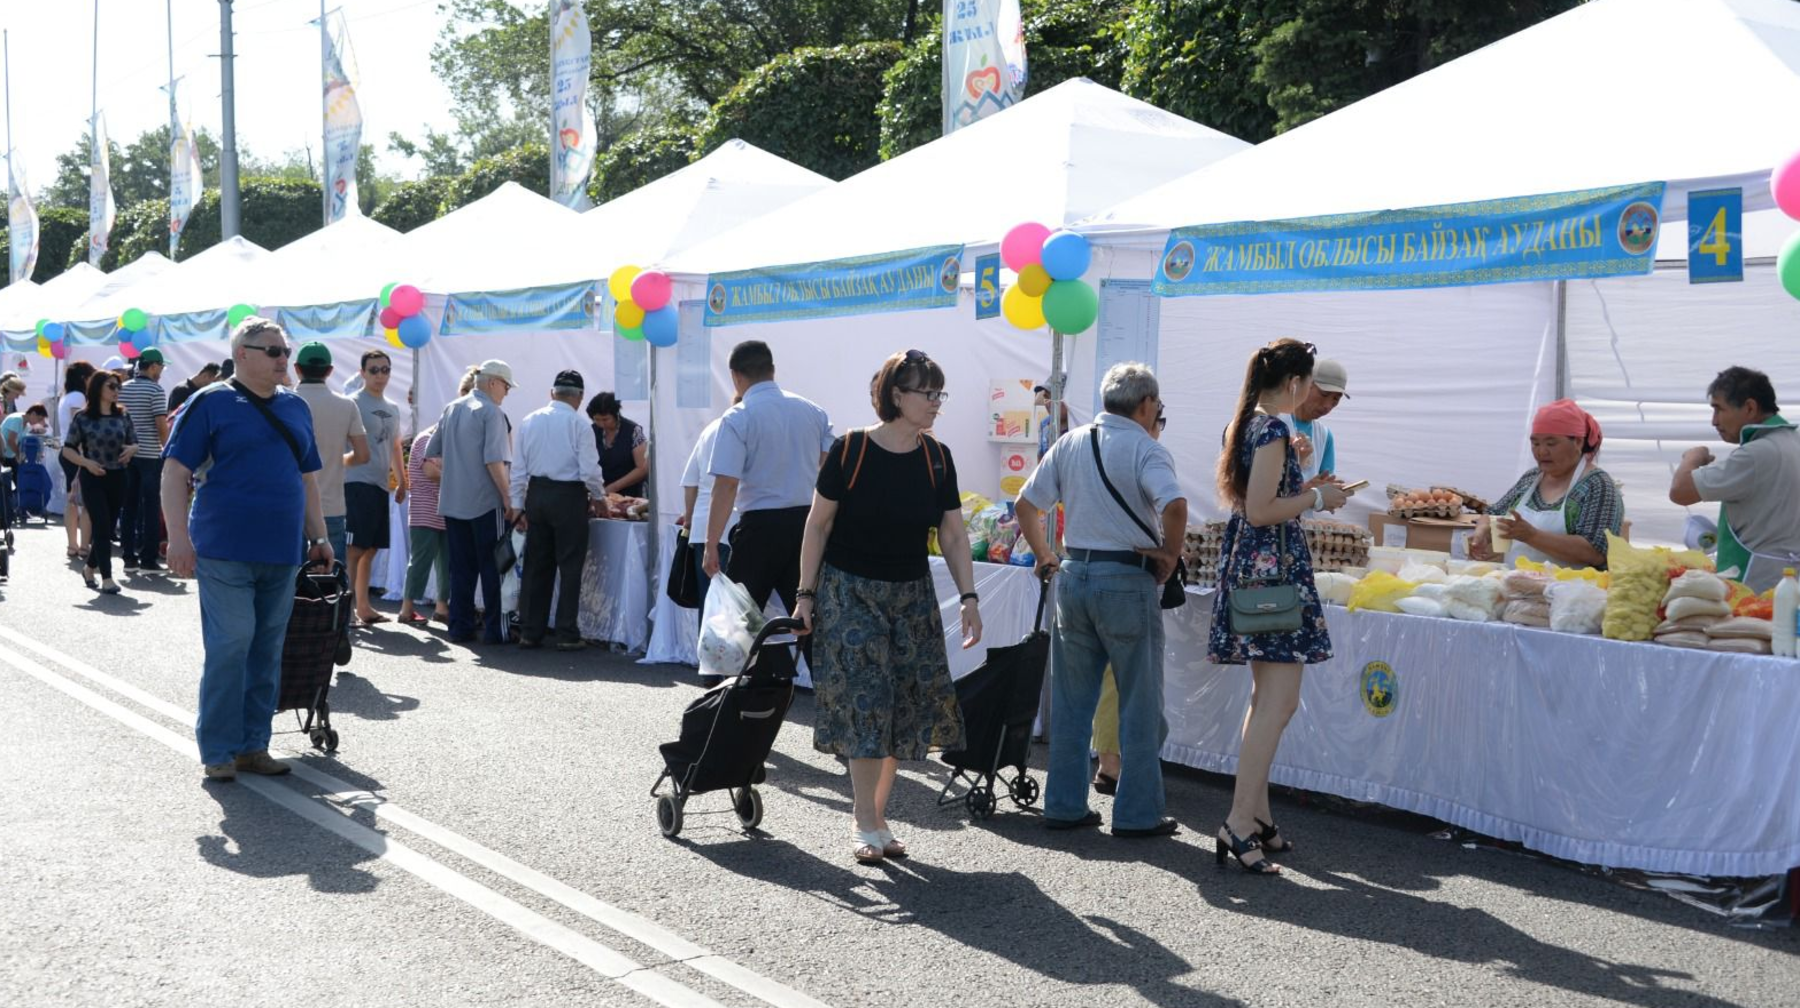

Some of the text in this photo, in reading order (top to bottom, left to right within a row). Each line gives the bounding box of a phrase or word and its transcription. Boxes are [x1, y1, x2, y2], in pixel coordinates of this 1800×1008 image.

[1203, 214, 1601, 272] ЖАМБЫЛ ОБЛЫСЫ БАЙЗАҚ АУДАНЫ
[1699, 206, 1731, 266] 4
[981, 266, 995, 308] 5
